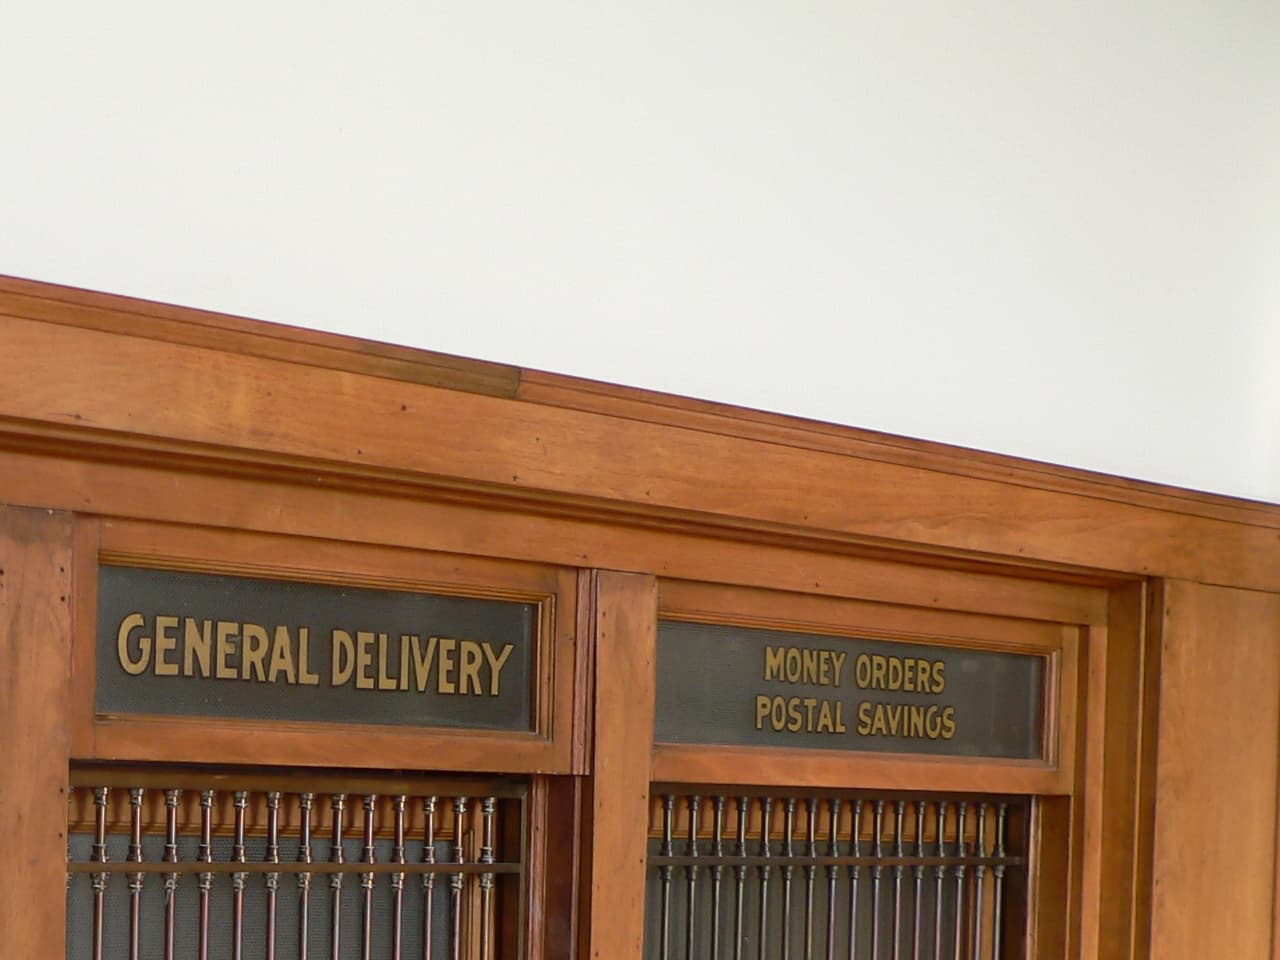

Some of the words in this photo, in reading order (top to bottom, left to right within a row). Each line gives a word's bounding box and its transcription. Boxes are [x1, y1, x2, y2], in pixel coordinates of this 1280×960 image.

[117, 612, 320, 685] GENERAL
[331, 629, 514, 696] DELIVERY
[764, 646, 847, 687] MONEY
[855, 654, 946, 694] ORDERS
[755, 695, 847, 733] POSTAL
[857, 702, 957, 739] SAVINGS
